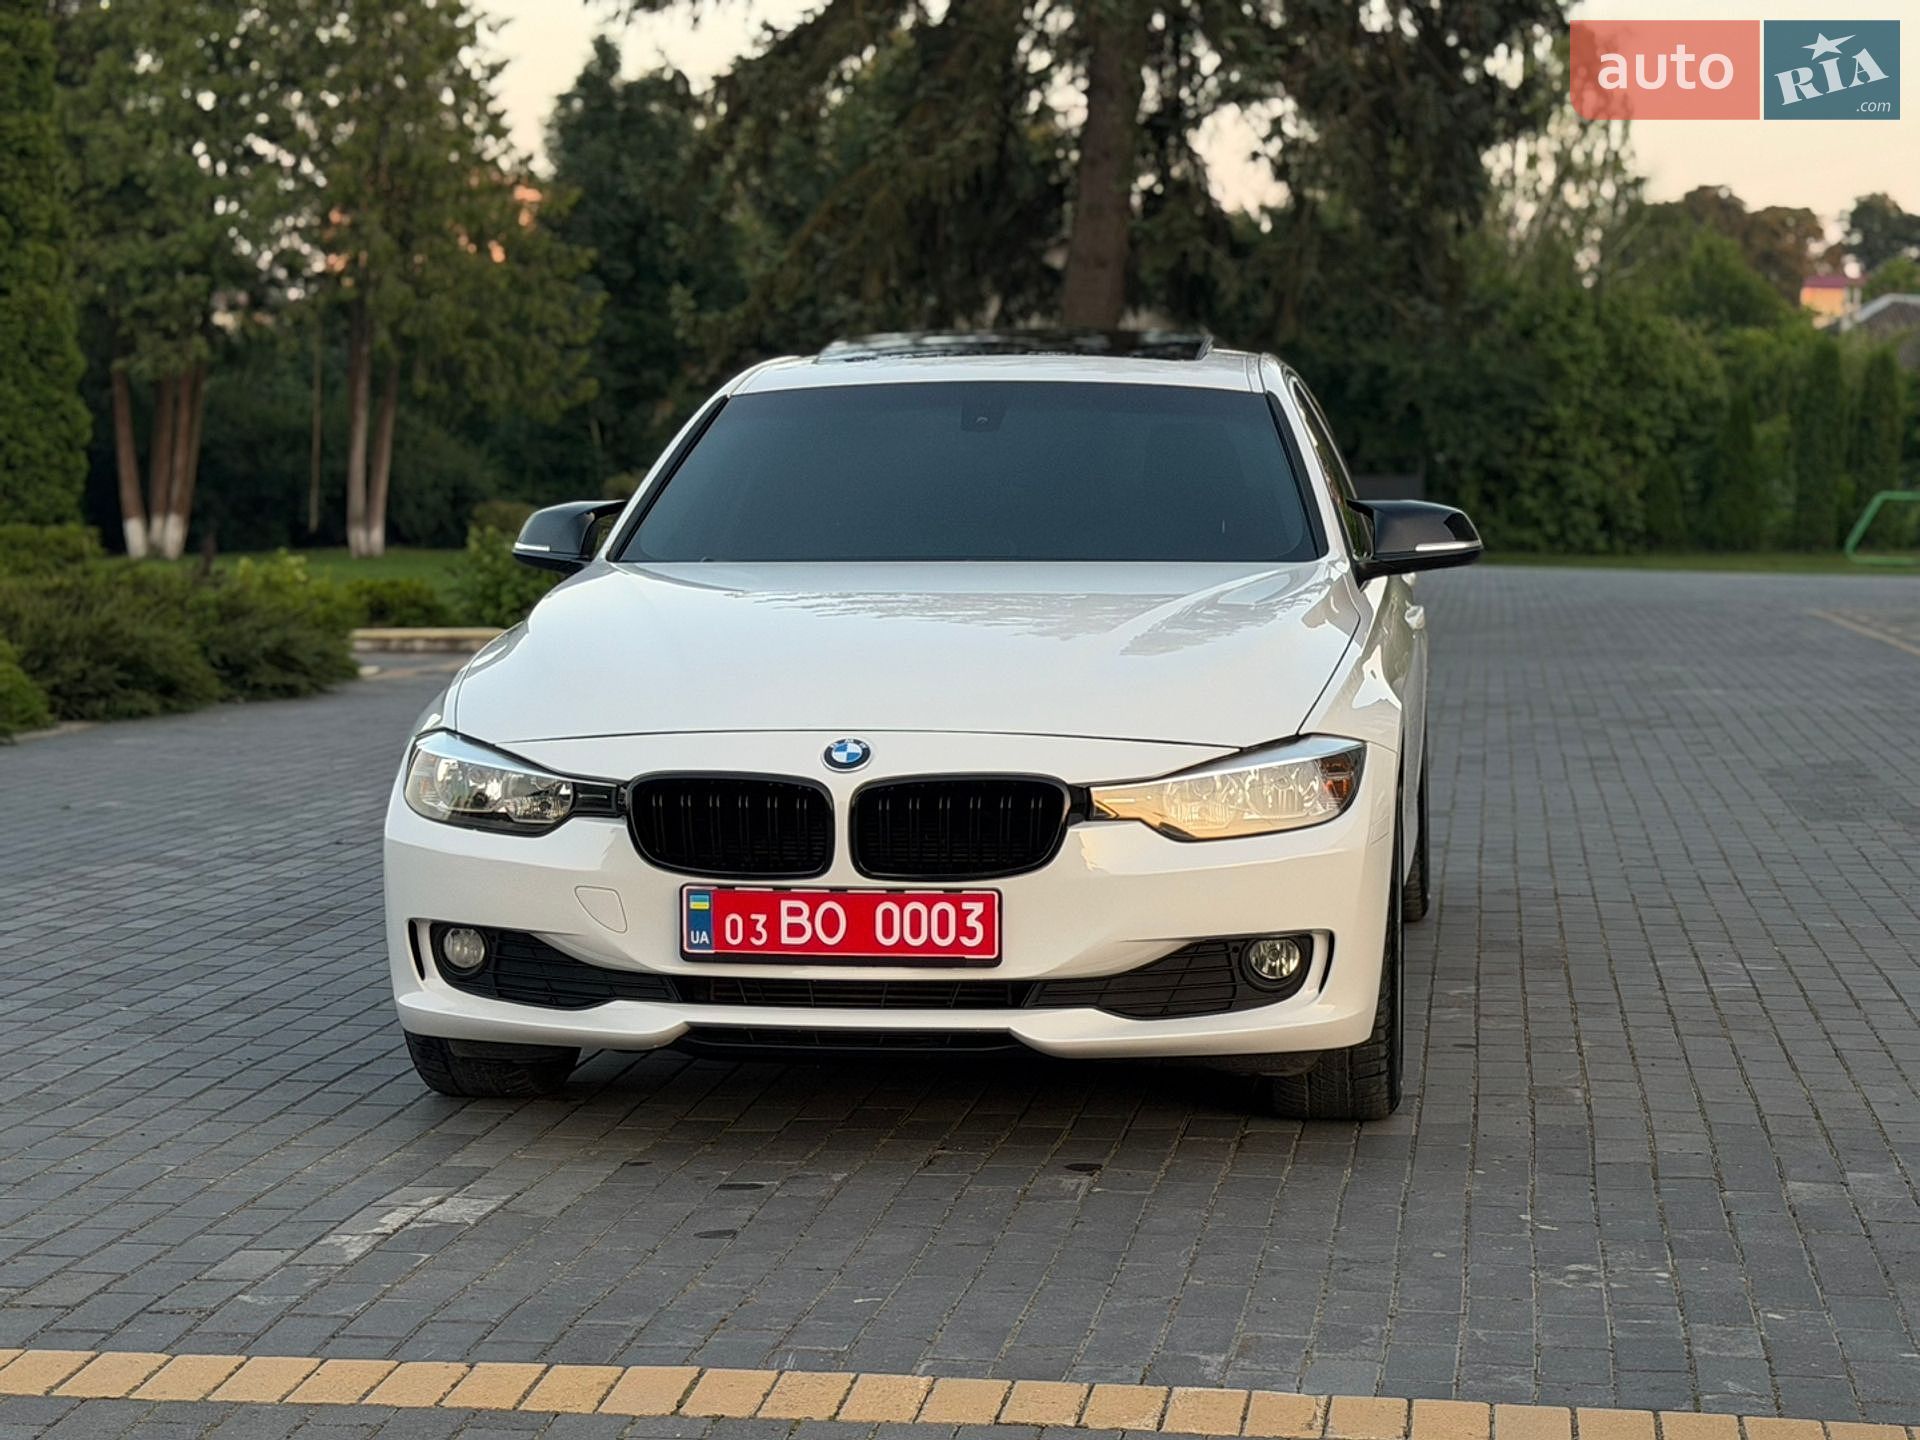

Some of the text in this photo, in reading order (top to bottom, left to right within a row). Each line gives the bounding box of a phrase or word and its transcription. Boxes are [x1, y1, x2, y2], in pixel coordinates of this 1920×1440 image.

[690, 930, 710, 944] UA
[724, 899, 984, 947] 03 BO 0003
